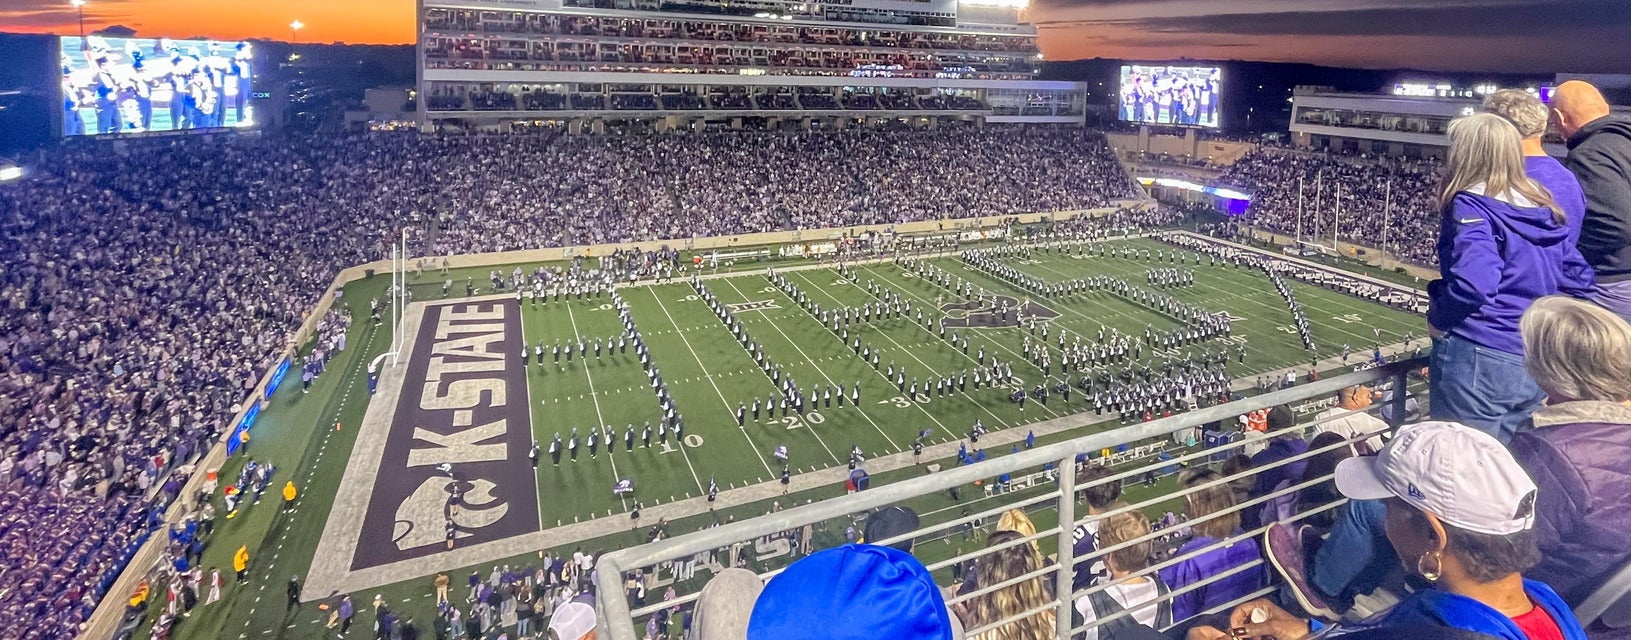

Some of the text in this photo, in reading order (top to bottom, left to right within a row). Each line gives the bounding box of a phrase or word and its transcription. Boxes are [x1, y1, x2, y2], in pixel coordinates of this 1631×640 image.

[406, 304, 508, 468] K-STATE
[890, 393, 931, 408] 30
[781, 411, 826, 430] 20
[659, 434, 704, 454] 10
